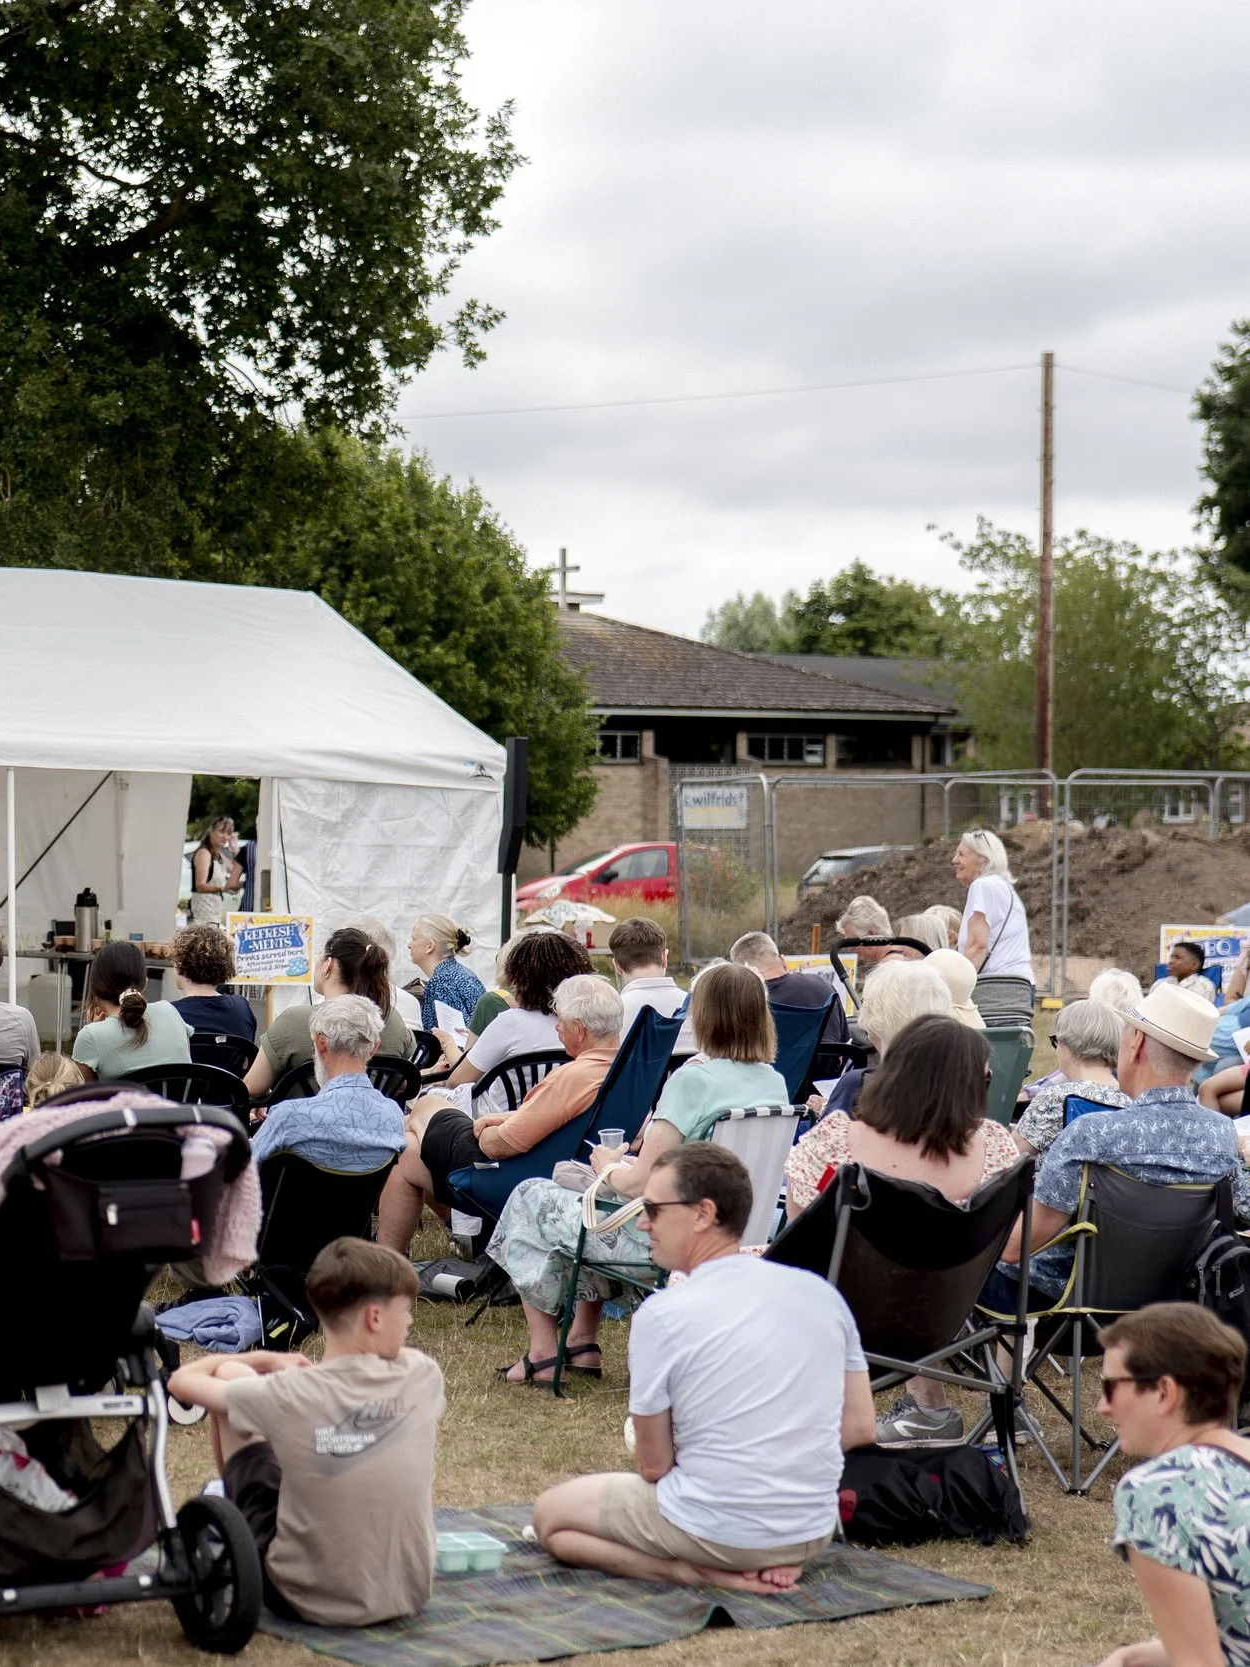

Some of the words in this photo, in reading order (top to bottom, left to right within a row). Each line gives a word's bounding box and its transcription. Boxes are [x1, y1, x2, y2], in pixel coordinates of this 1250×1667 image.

[244, 925, 295, 940] REFRESH
[248, 936, 292, 952] -MENTS
[236, 953, 260, 961] Drinks
[262, 949, 286, 958] served
